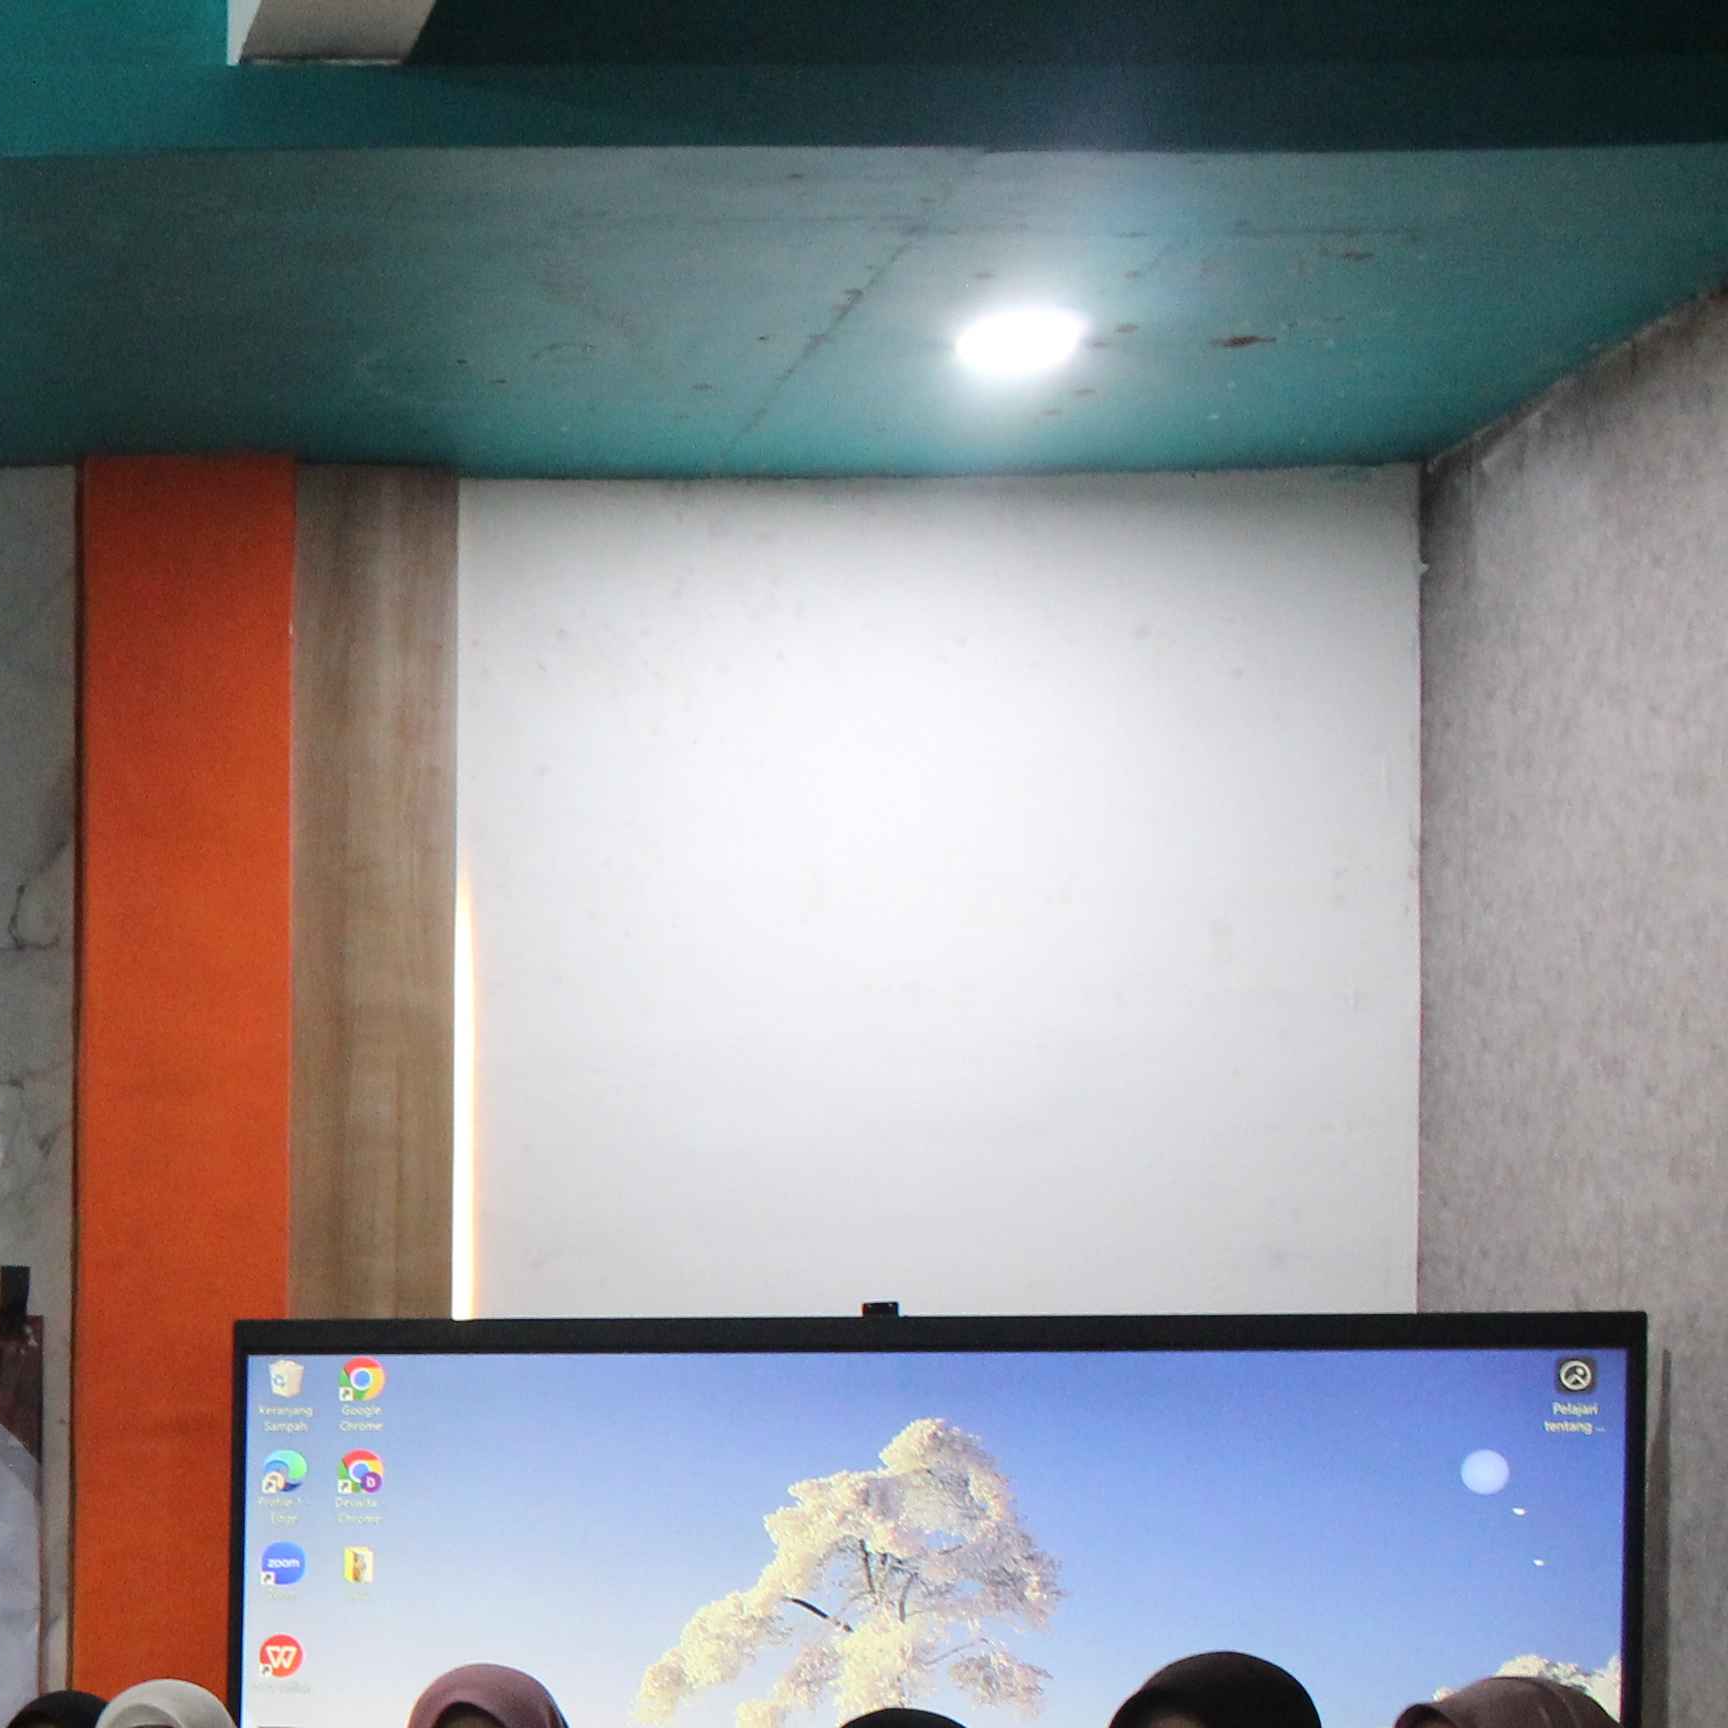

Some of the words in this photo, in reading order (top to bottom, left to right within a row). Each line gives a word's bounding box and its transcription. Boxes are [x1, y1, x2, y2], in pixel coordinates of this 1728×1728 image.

[341, 1404, 382, 1418] Google
[338, 1421, 384, 1432] Chrome
[267, 1558, 300, 1569] zoom
